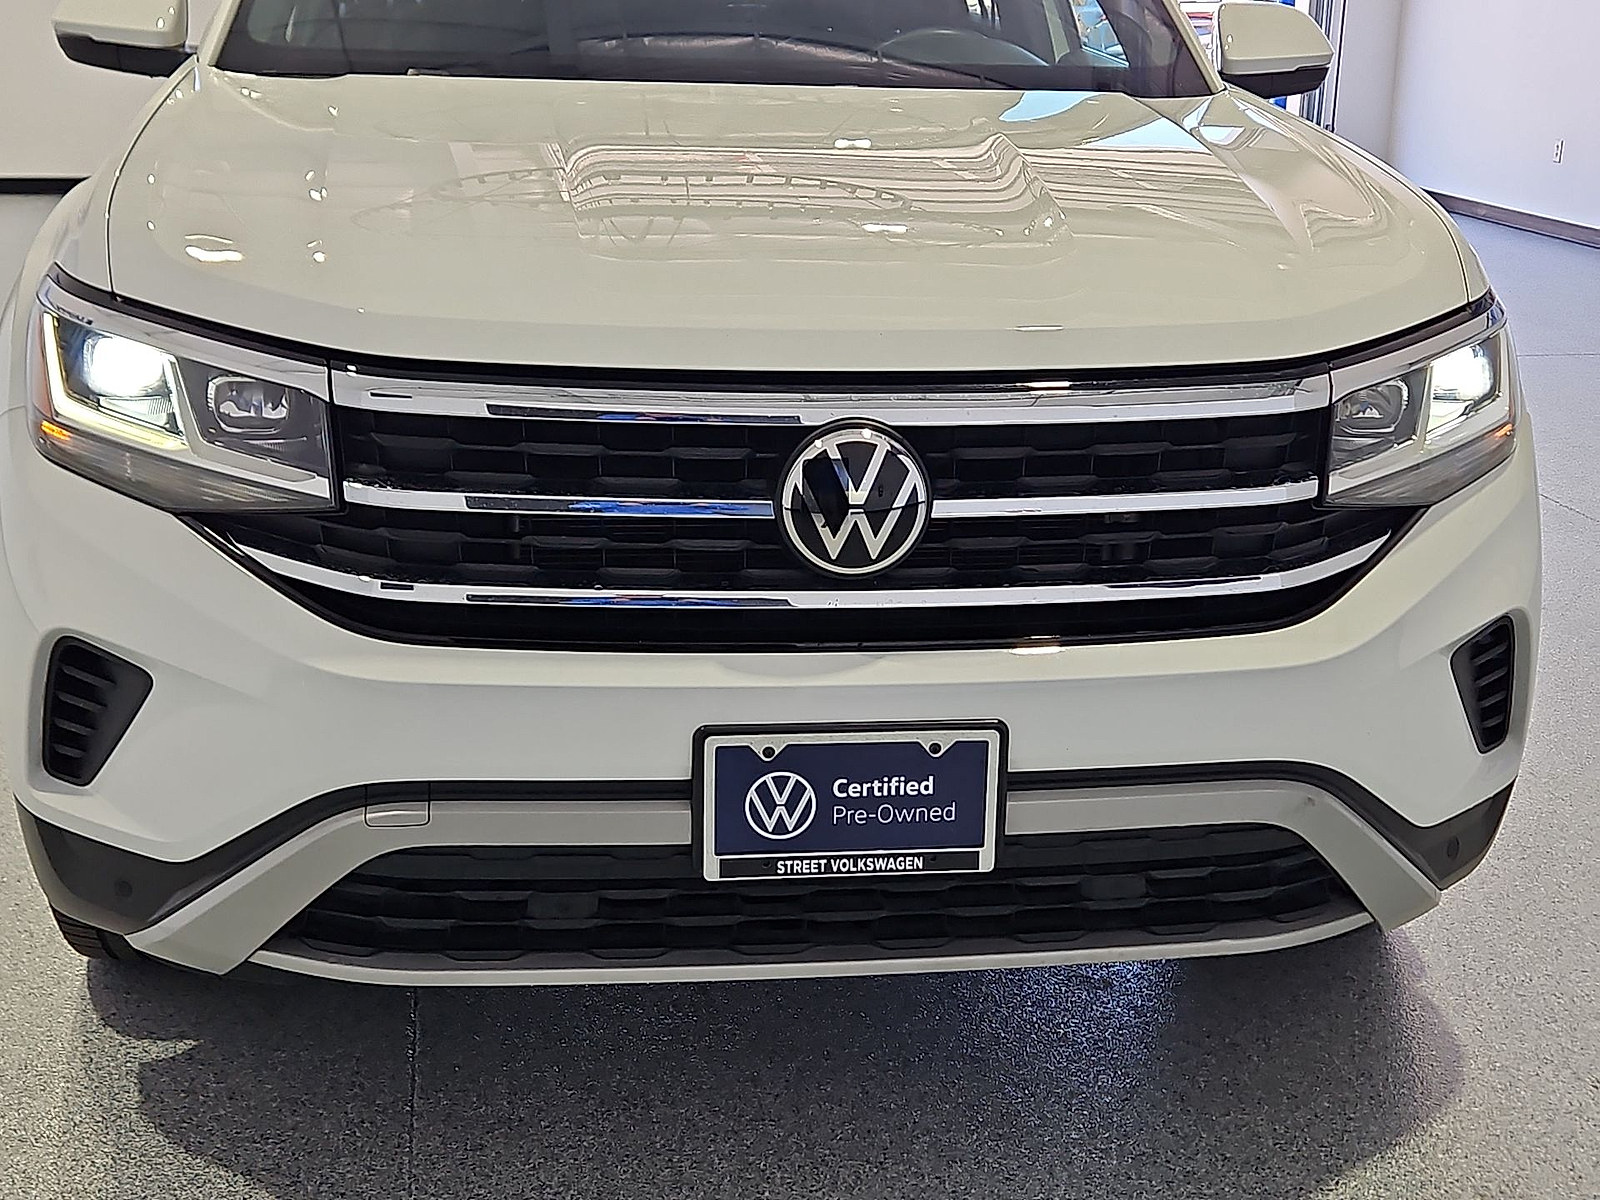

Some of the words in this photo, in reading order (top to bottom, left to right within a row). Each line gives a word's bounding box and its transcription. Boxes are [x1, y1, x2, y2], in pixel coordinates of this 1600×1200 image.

[832, 776, 934, 797] Certified
[833, 802, 956, 825] Pre-Owned
[776, 858, 826, 874] STREET
[830, 856, 924, 872] VOLKSWAGEN
